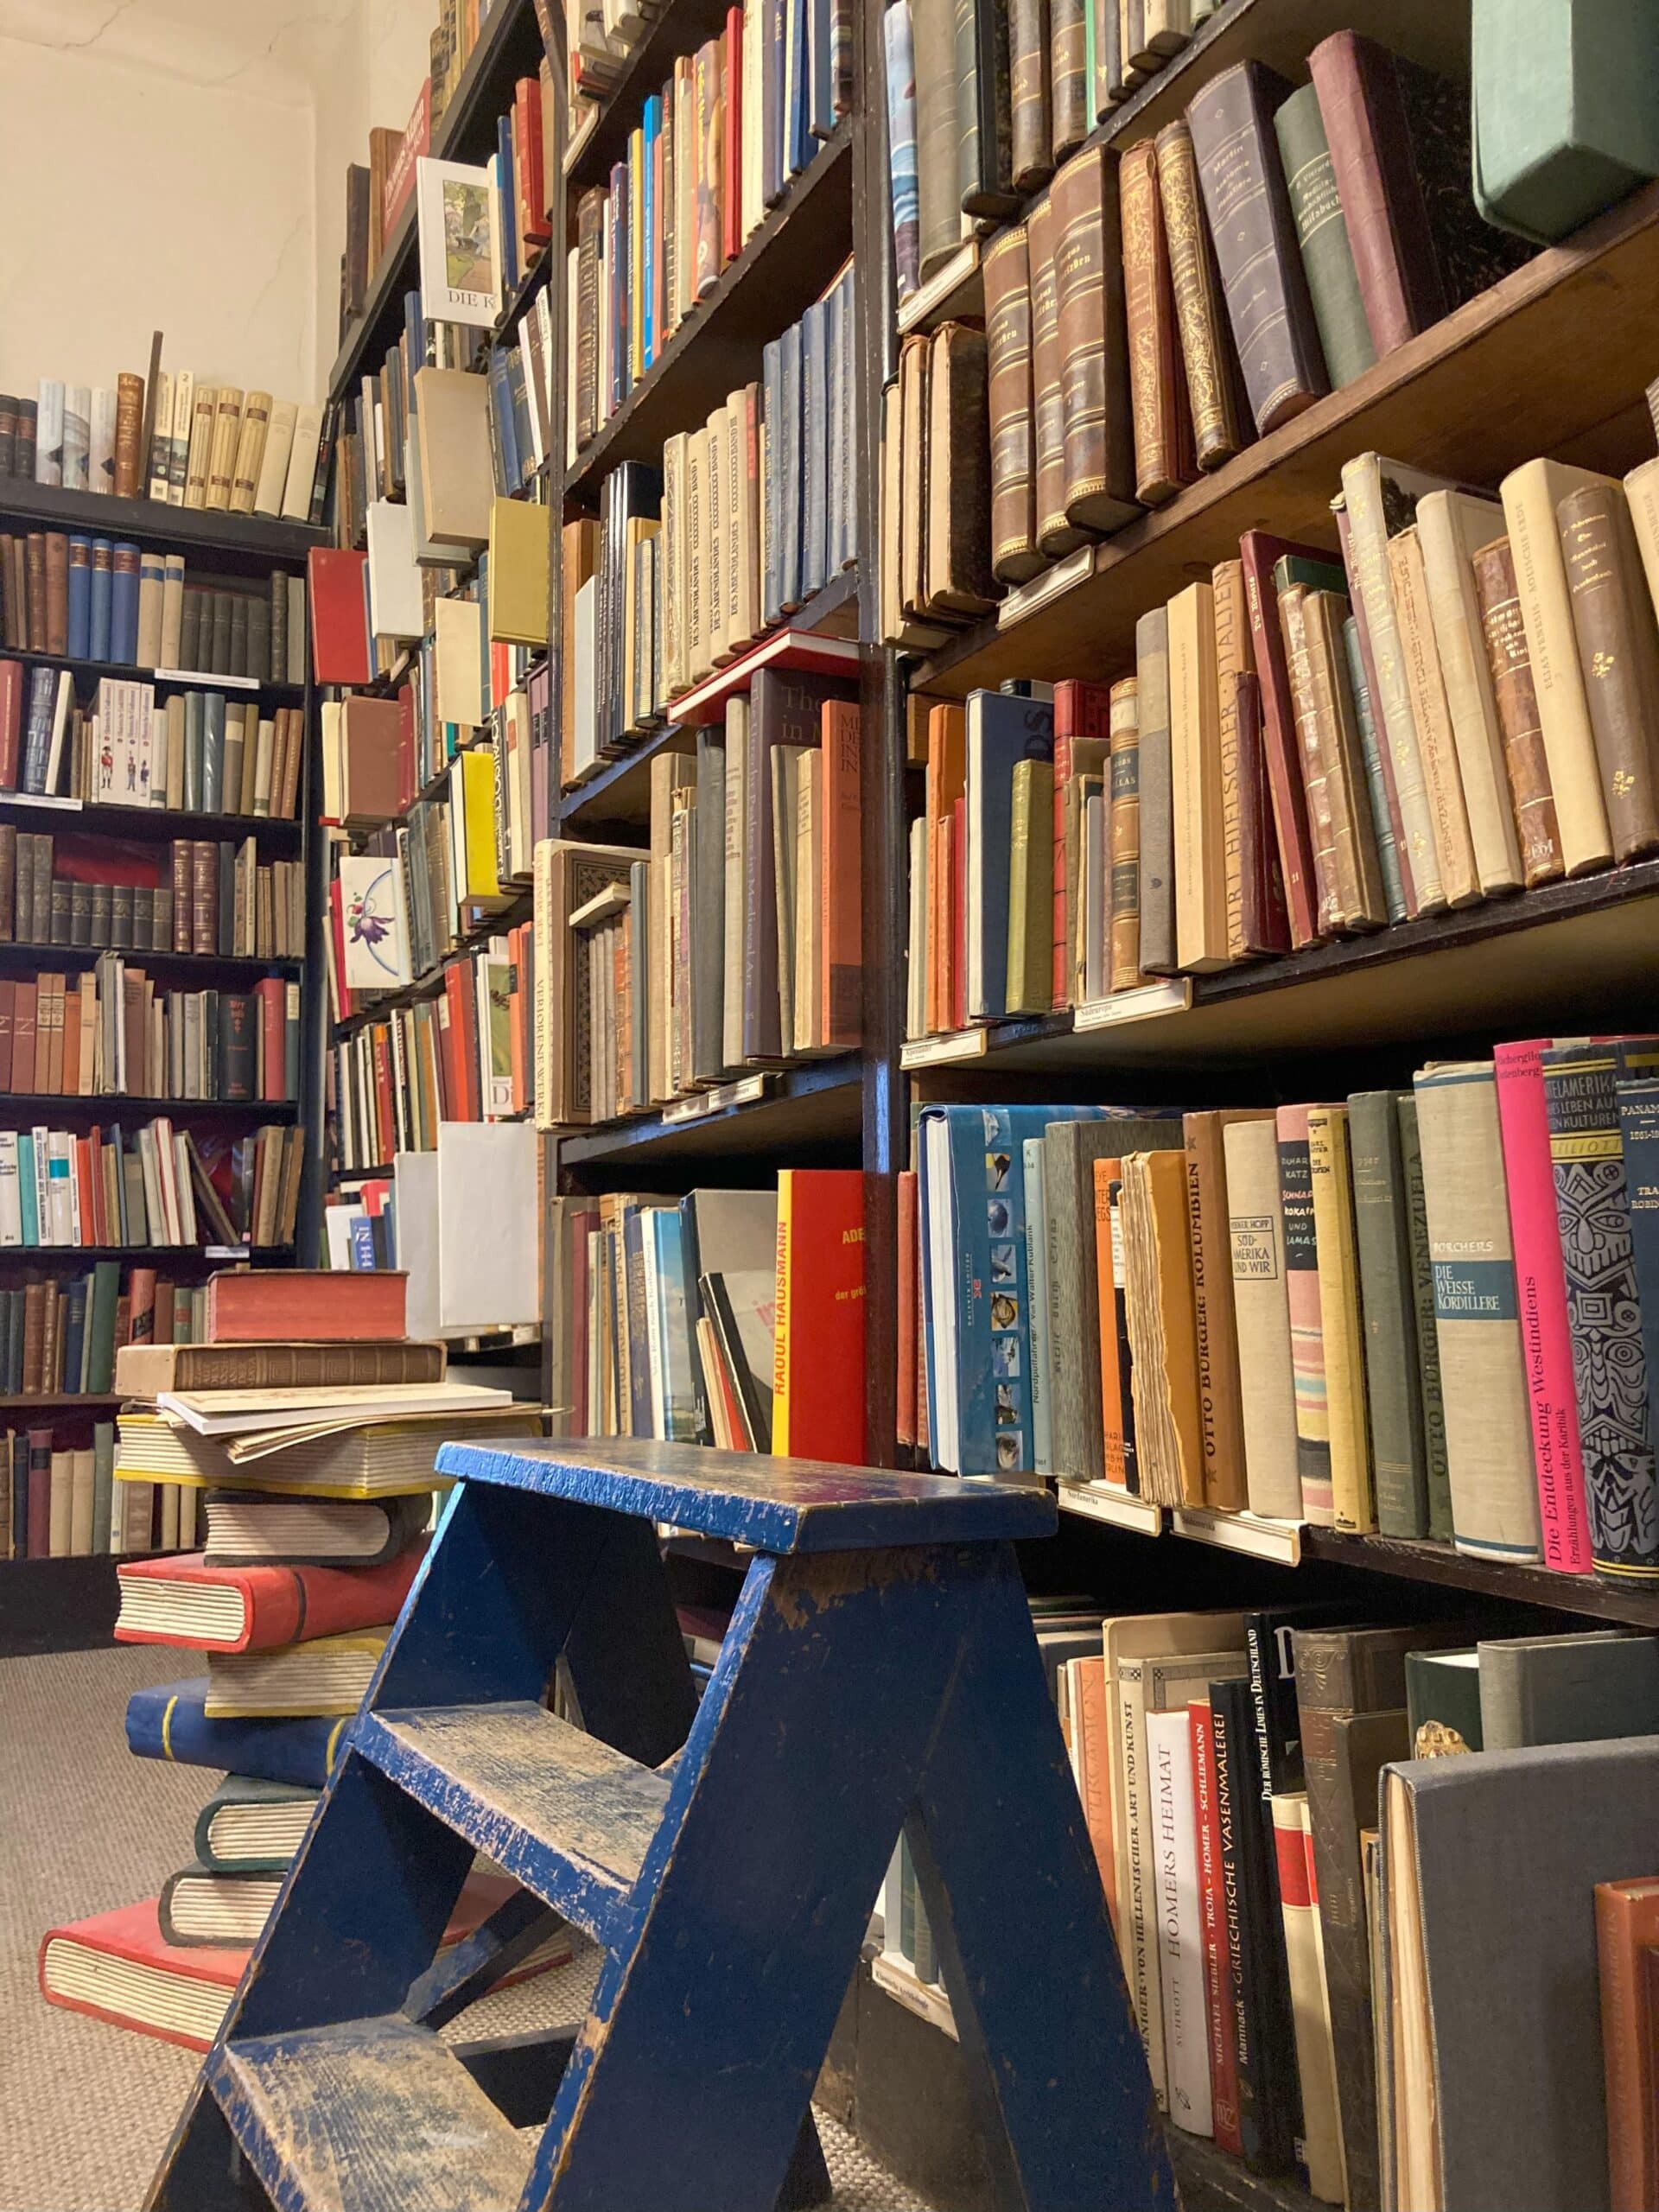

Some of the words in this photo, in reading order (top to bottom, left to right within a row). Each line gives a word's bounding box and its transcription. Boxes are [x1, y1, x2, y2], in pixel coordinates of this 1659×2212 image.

[448, 290, 479, 308] DIE
[1532, 603, 1547, 652] VENESIS
[1538, 656, 1553, 690] ELIAS
[1219, 704, 1240, 855] HIELSCHER
[1224, 872, 1242, 949] KURT
[1561, 1098, 1593, 1115] LEBEN
[1285, 1170, 1308, 1179] KATZ
[1187, 1161, 1205, 1287] KOLUMBIEN
[1288, 1223, 1307, 1231] UND
[1408, 1152, 1432, 1288] VENEZUELA
[775, 1220, 788, 1326] HAUSMANN
[835, 1288, 849, 1300] der
[1249, 1261, 1271, 1274] WIR
[1434, 1265, 1453, 1280] DIE
[1435, 1280, 1476, 1294] WEISSE
[1437, 1294, 1501, 1311] KORDILLERE
[1525, 1275, 1545, 1394] Westindiens
[773, 1333, 787, 1396] RAOUL
[1200, 1396, 1217, 1459] OTTO
[1427, 1410, 1446, 1477] OTTO
[1555, 1408, 1570, 1451] Karibik
[1538, 1402, 1557, 1520] Entdeckung
[1561, 1451, 1573, 1471] der
[1565, 1472, 1575, 1491] aus
[1545, 1529, 1562, 1563] Die
[1566, 1493, 1581, 1565] Erzählungen
[1123, 1700, 1135, 1751] KUNST
[1127, 1754, 1137, 1786] UND
[1158, 1744, 1177, 1841] HEIMAT
[1195, 1722, 1210, 1811] SCHLIEMANN
[1213, 1713, 1235, 1852] VASENMALEREI
[1128, 1789, 1139, 1822] ART
[1200, 1824, 1213, 1875] HOMER
[1130, 1826, 1146, 1942] HELLENISCHER
[1163, 1849, 1182, 1960] HOMERS
[1204, 1886, 1216, 1929] TROIA
[1223, 1860, 1244, 1985] GRIECHISCHE
[1135, 1946, 1147, 1978] VON
[1208, 1942, 1221, 1997] SIEBLER
[1172, 1977, 1184, 2049] SCHROTT
[1211, 2004, 1225, 2066] MICHAEL
[1235, 1999, 1249, 2065] Mannack
